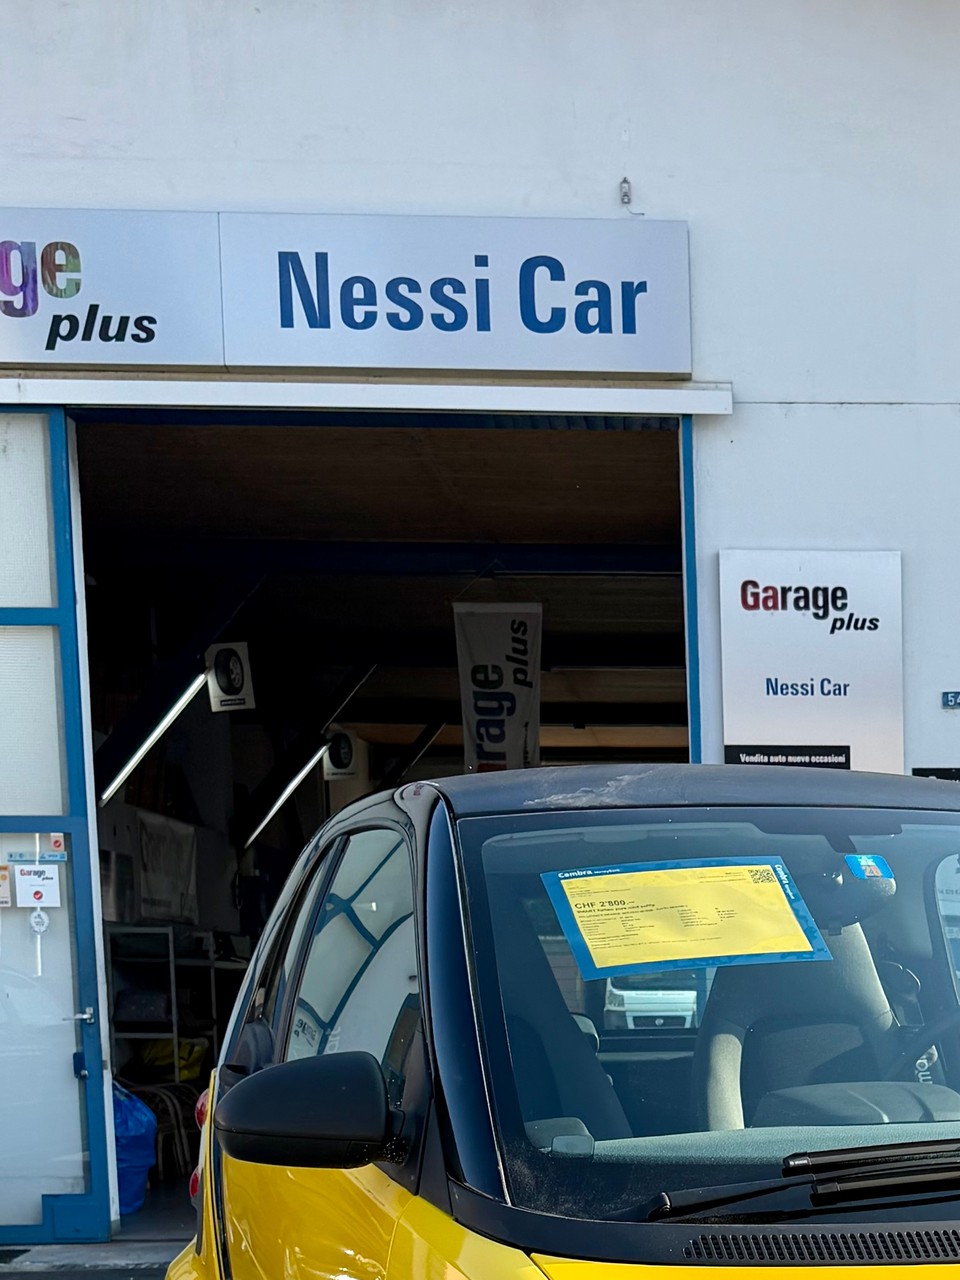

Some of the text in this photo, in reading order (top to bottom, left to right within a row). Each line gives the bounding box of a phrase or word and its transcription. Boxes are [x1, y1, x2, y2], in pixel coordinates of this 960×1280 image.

[278, 251, 648, 335] Nessi Car
[45, 304, 157, 351] plus
[740, 579, 848, 620] Garage
[830, 613, 880, 634] plus
[505, 619, 533, 688] plus
[766, 677, 850, 697] Nessi Car
[740, 753, 769, 763] Vendita
[769, 755, 786, 763] auto
[811, 754, 846, 763] occasioni
[575, 902, 596, 910] CHF
